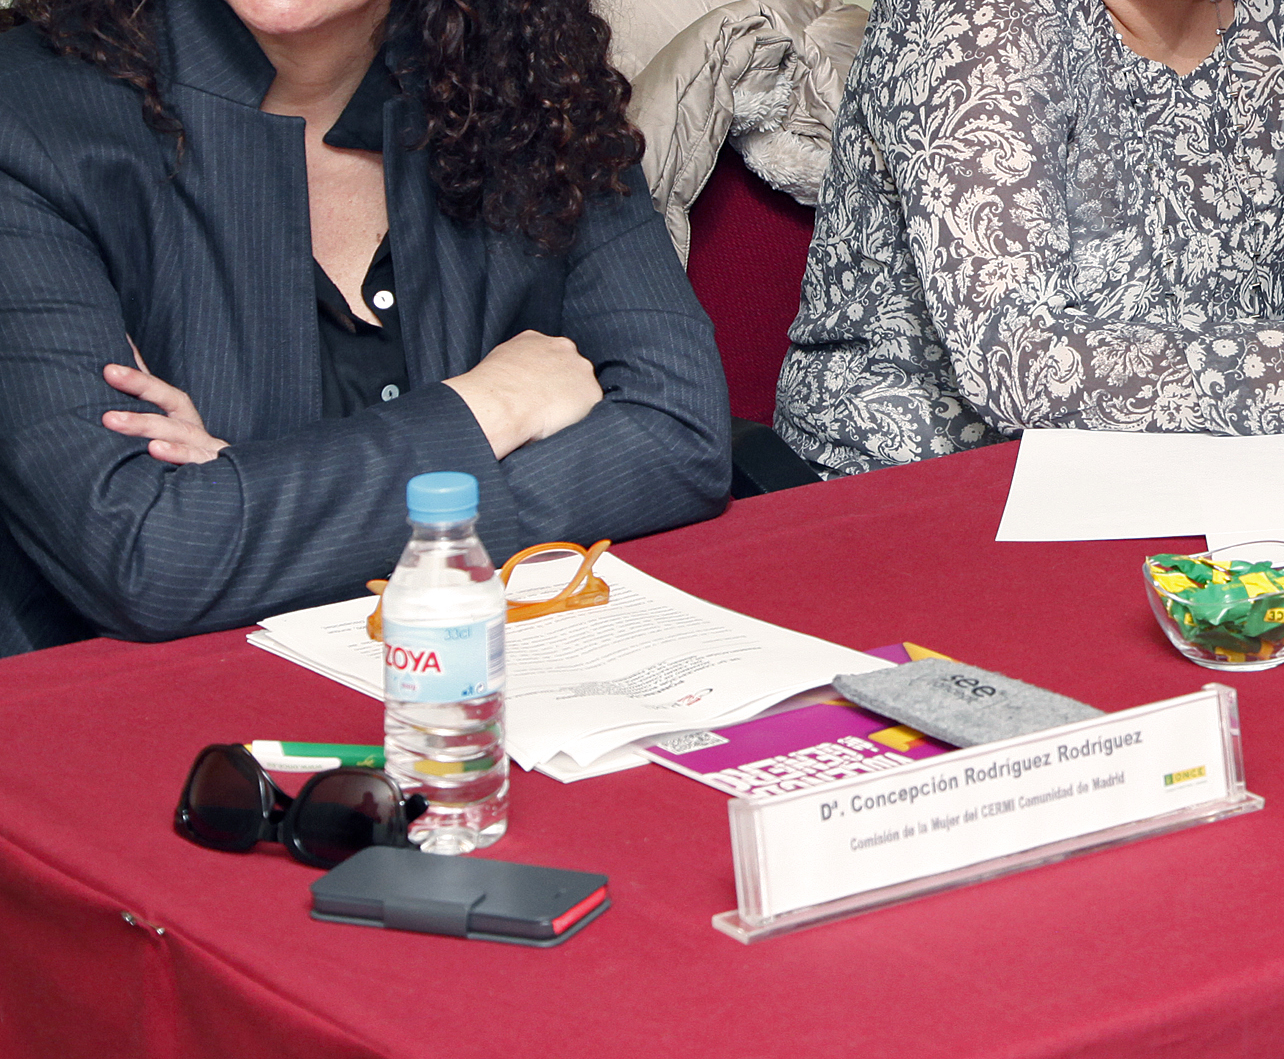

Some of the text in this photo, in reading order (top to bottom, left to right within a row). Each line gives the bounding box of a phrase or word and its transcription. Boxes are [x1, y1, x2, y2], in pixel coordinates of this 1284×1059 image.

[850, 771, 1125, 851] Comisión de la Mujer del CERMI Comunidad de Madrid
[851, 774, 959, 813] Concepción
[964, 752, 1052, 785] Rodríguez
[1057, 730, 1143, 763] Rodríguez
[1174, 767, 1204, 782] ONCE
